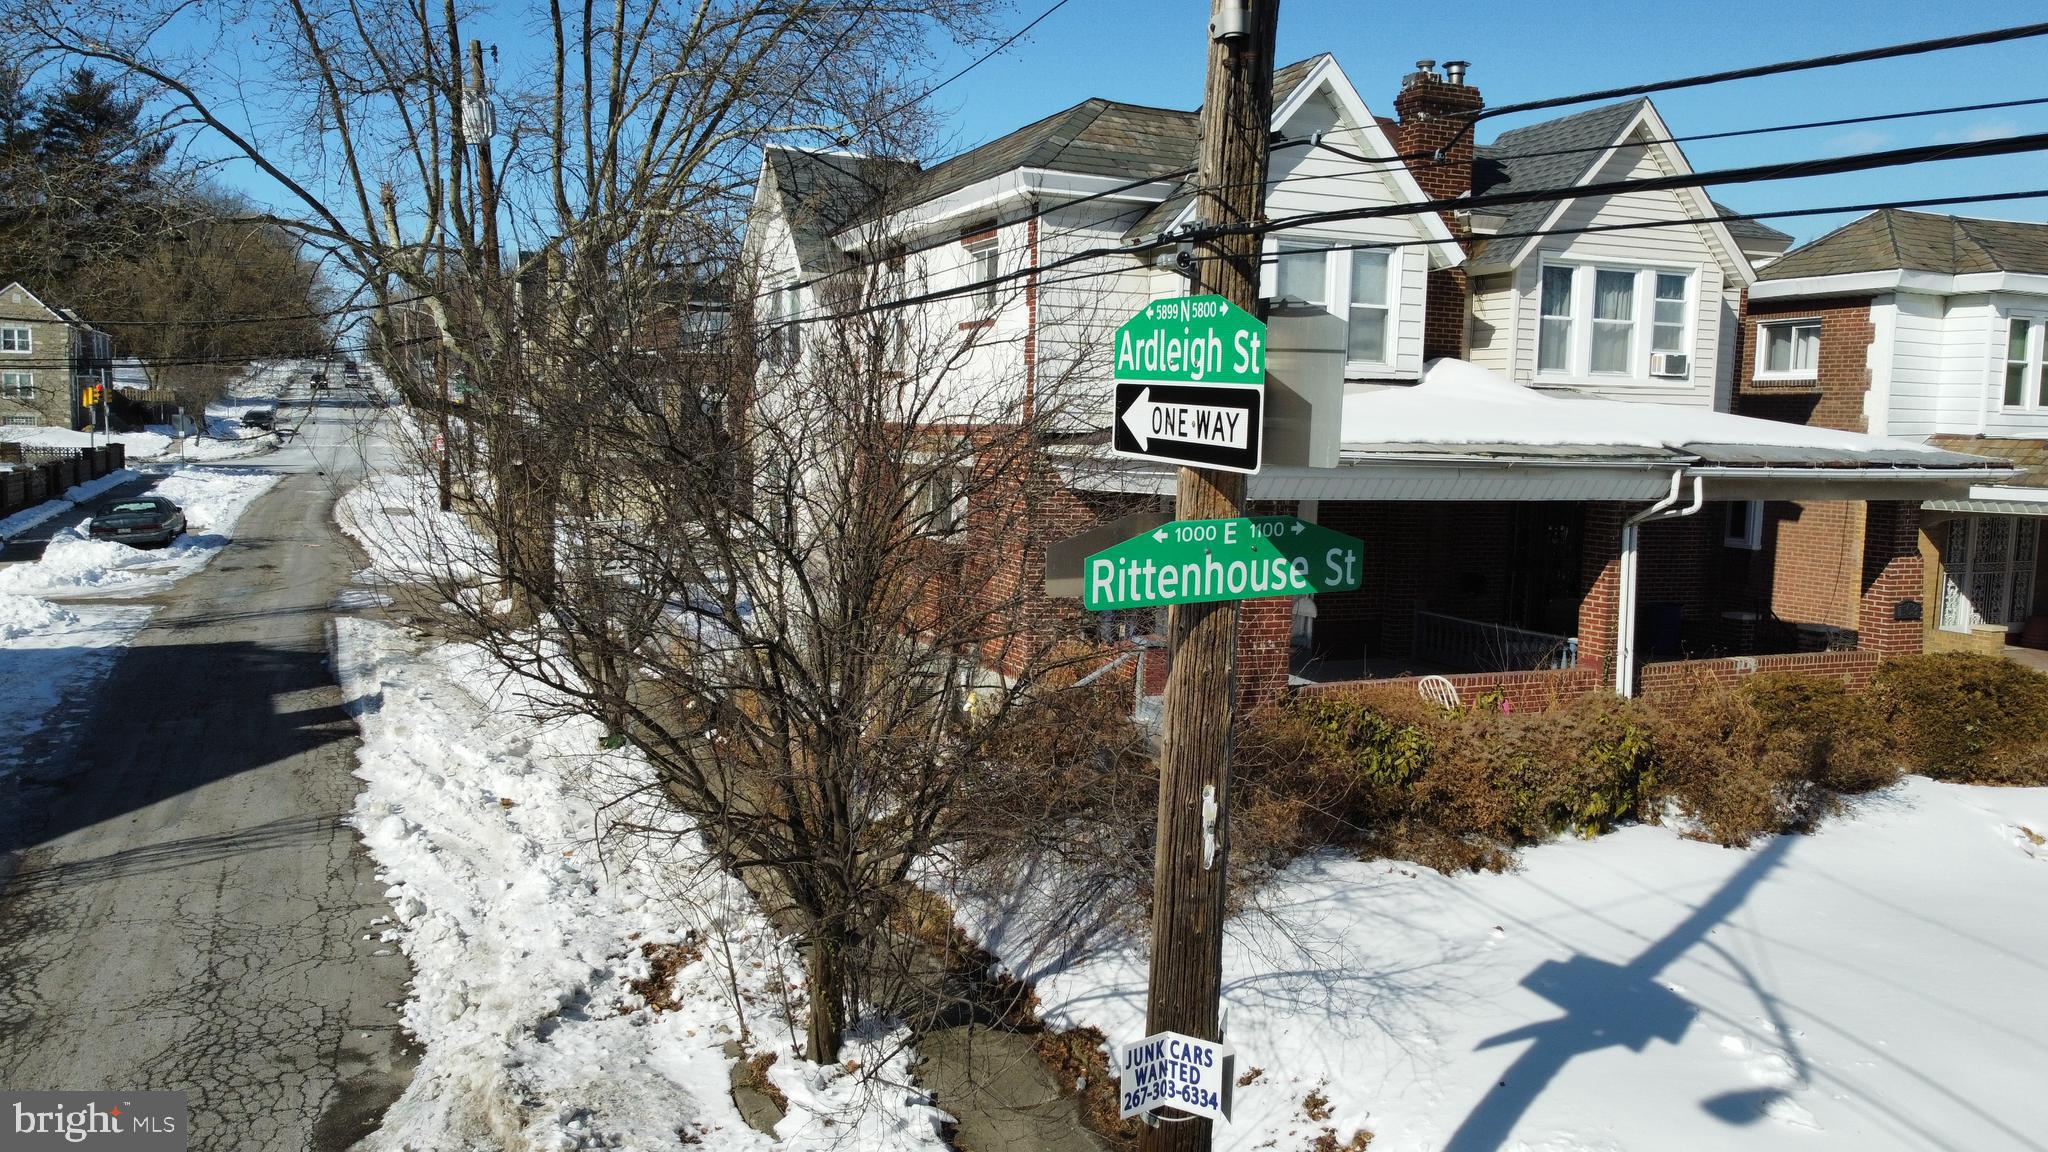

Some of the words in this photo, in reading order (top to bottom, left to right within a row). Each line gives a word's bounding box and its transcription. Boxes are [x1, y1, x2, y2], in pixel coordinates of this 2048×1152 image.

[1156, 304, 1178, 320] 5899
[1180, 300, 1190, 322] N
[1192, 301, 1217, 318] 5800
[1118, 327, 1222, 380] Ardleigh
[1233, 329, 1261, 374] St
[1152, 406, 1188, 437] ONE
[1196, 409, 1240, 442] WAY
[1175, 525, 1217, 542] 1000
[1224, 522, 1237, 544] E
[1250, 522, 1285, 538] 1100
[1092, 550, 1309, 604] Rittenhouse
[1324, 548, 1357, 586] St
[1126, 1040, 1165, 1070] JUNK
[1170, 1040, 1213, 1068] CARS
[1135, 1059, 1200, 1087] WANTED
[1124, 1080, 1218, 1110] 267-303-6334
